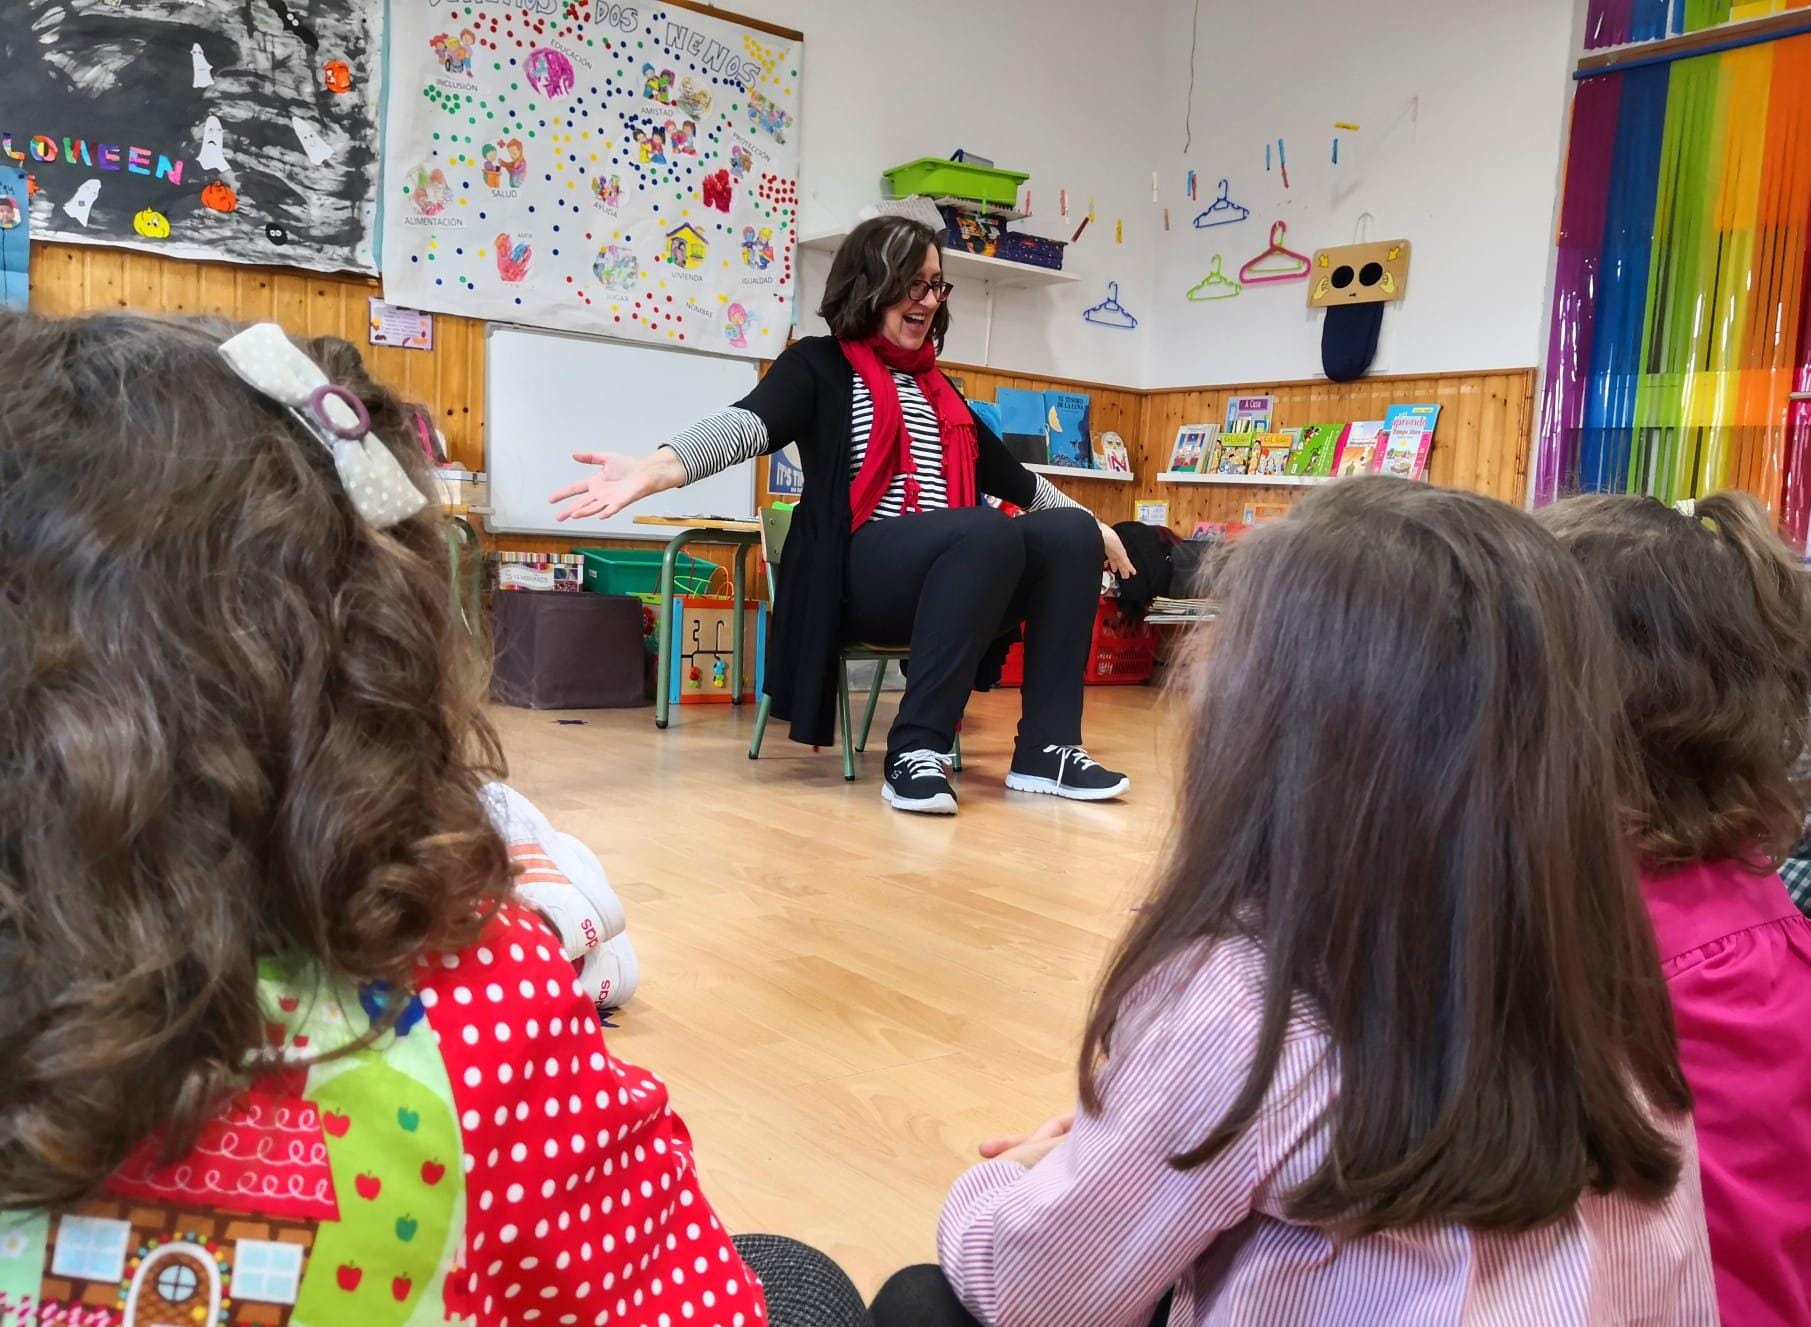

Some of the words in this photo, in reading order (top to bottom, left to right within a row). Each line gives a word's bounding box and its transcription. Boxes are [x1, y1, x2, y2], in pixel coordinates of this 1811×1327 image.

[595, 0, 638, 33] DOS
[665, 22, 761, 89] NENOS
[549, 38, 593, 70] EDUCACIÓN
[436, 79, 479, 92] INCLUSIÓN
[640, 106, 674, 117] AMISTAD
[1, 131, 185, 186] LOWEEN
[491, 189, 518, 199] SALUD
[593, 201, 618, 218] AYUDA
[404, 216, 463, 227] ALIMENTACIÓN
[671, 271, 704, 282] VIVIENDA
[741, 277, 774, 285] IGUALDAD
[685, 301, 714, 319] NOMBRE
[776, 462, 792, 487] IT'S
